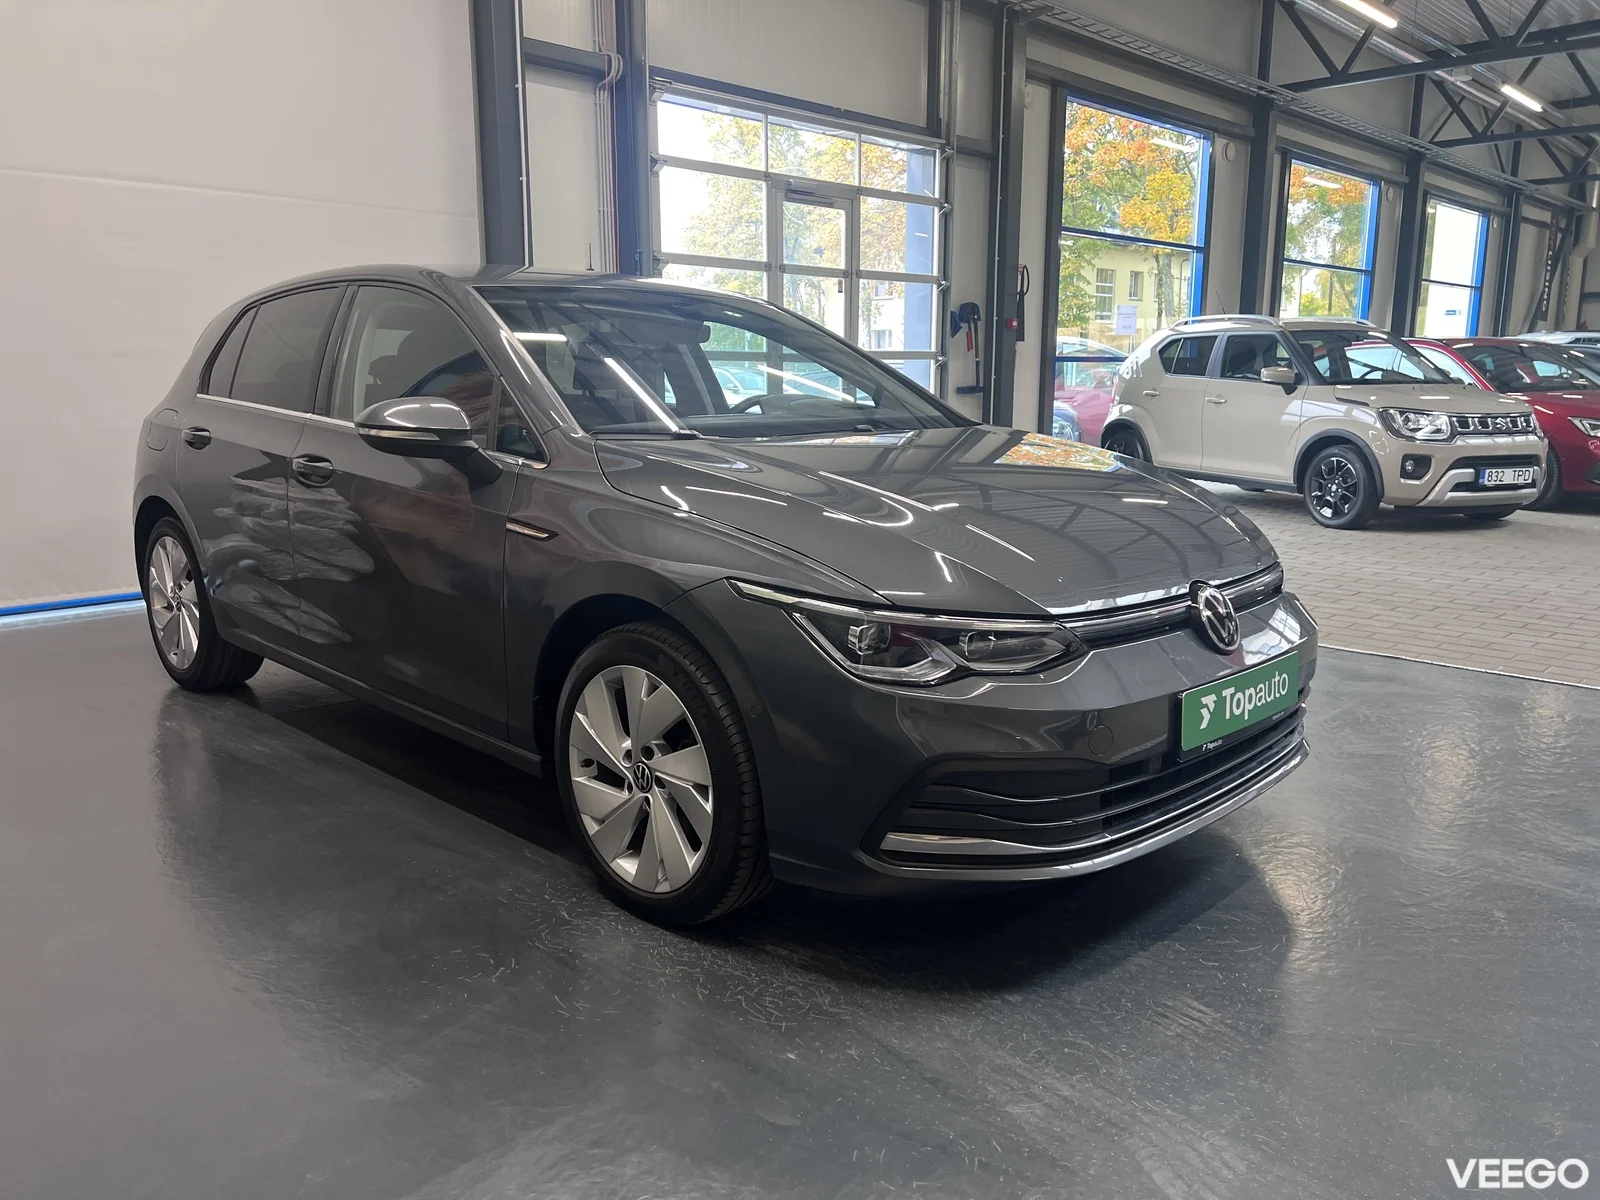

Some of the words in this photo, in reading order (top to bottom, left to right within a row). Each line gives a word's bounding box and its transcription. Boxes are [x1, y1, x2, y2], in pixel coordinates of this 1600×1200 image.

[1487, 470, 1505, 482] 832
[1512, 469, 1531, 482] TPD
[1222, 671, 1289, 720] Topauto
